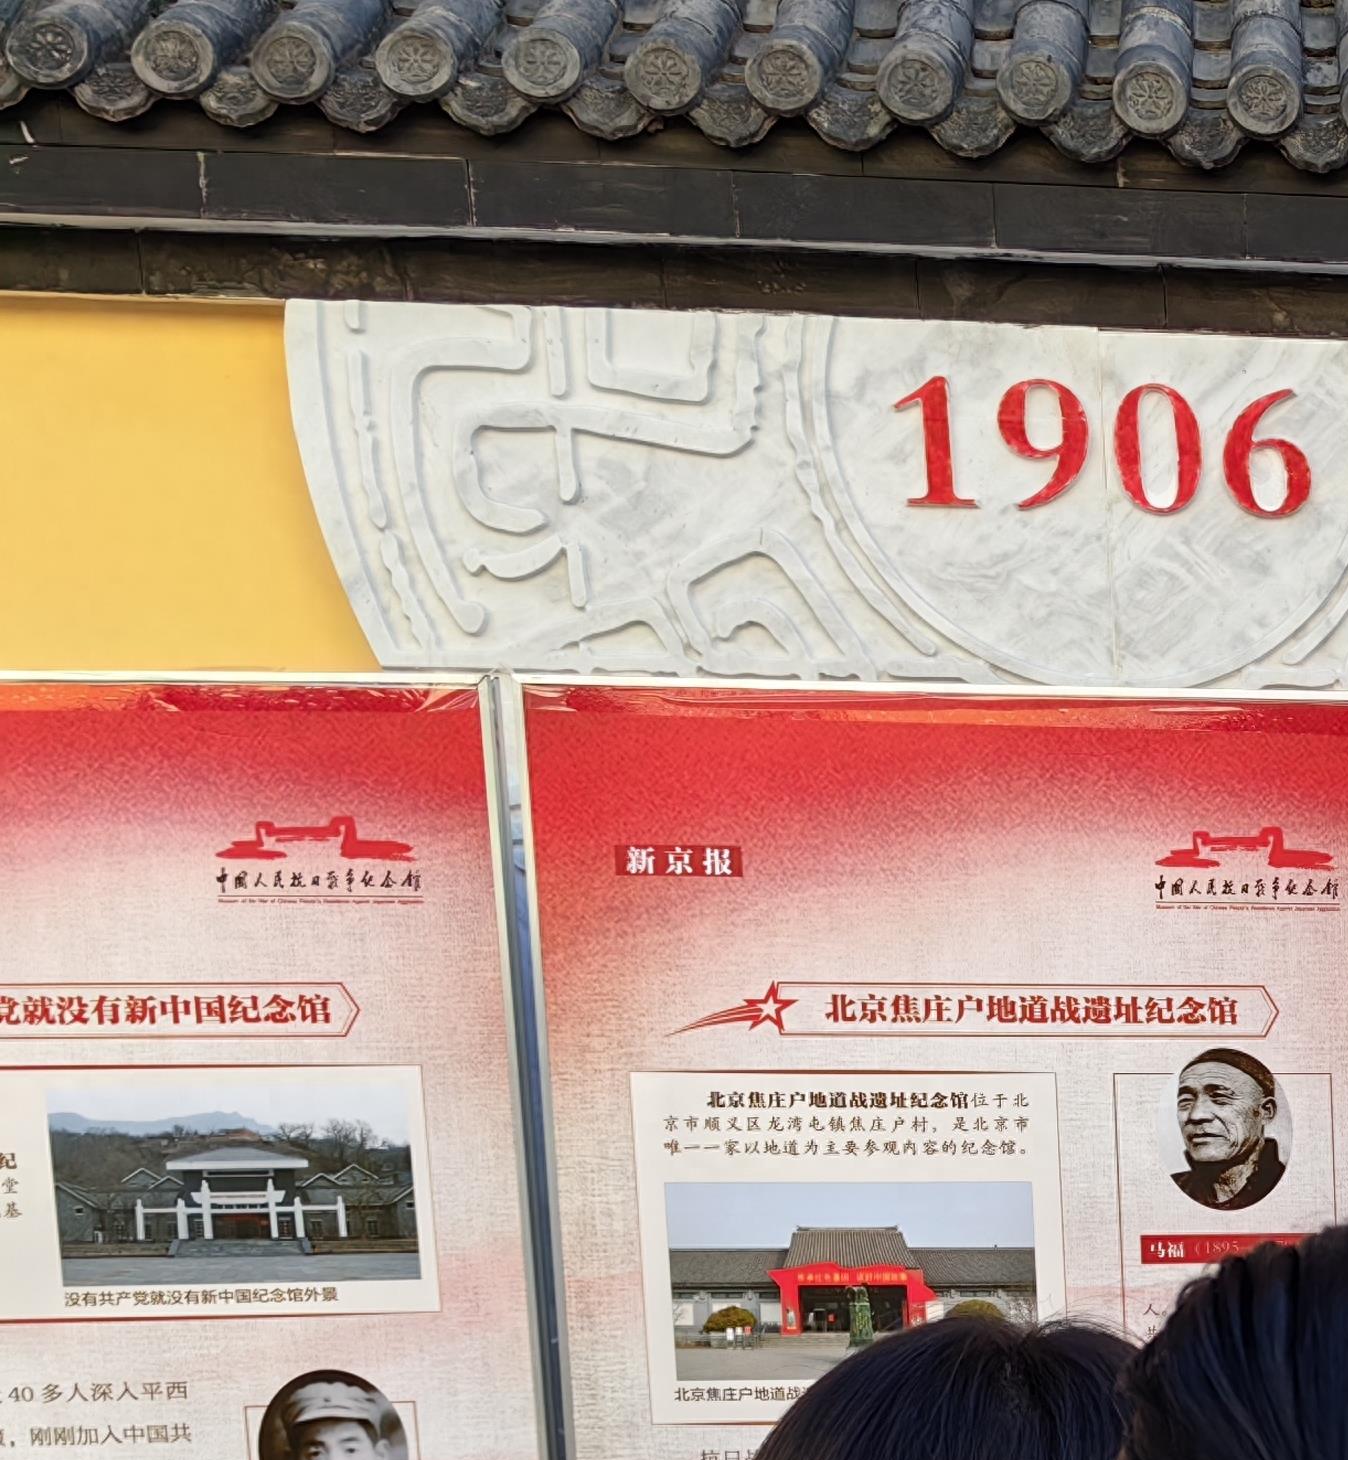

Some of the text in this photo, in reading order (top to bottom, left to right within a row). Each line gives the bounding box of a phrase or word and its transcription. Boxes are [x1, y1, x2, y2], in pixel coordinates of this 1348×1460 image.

[891, 375, 1312, 520] 1906
[626, 846, 733, 874] 新京报
[825, 992, 1238, 1029] 北京焦庄户地道战遗址纪念馆
[706, 1090, 1030, 1110] 北京焦庄户地道战遗址纪念馆位于北
[662, 1114, 1031, 1135] 京市顺义区龙湾屯镇焦庄户村，是北京市
[663, 1138, 1029, 1157] 唯一一家以地道为主要参观内容的纪念馆。
[64, 1288, 339, 1308] 没有共产党就没有新中国纪念馆外景
[0, 1423, 192, 1448] ，刚刚加入中国共
